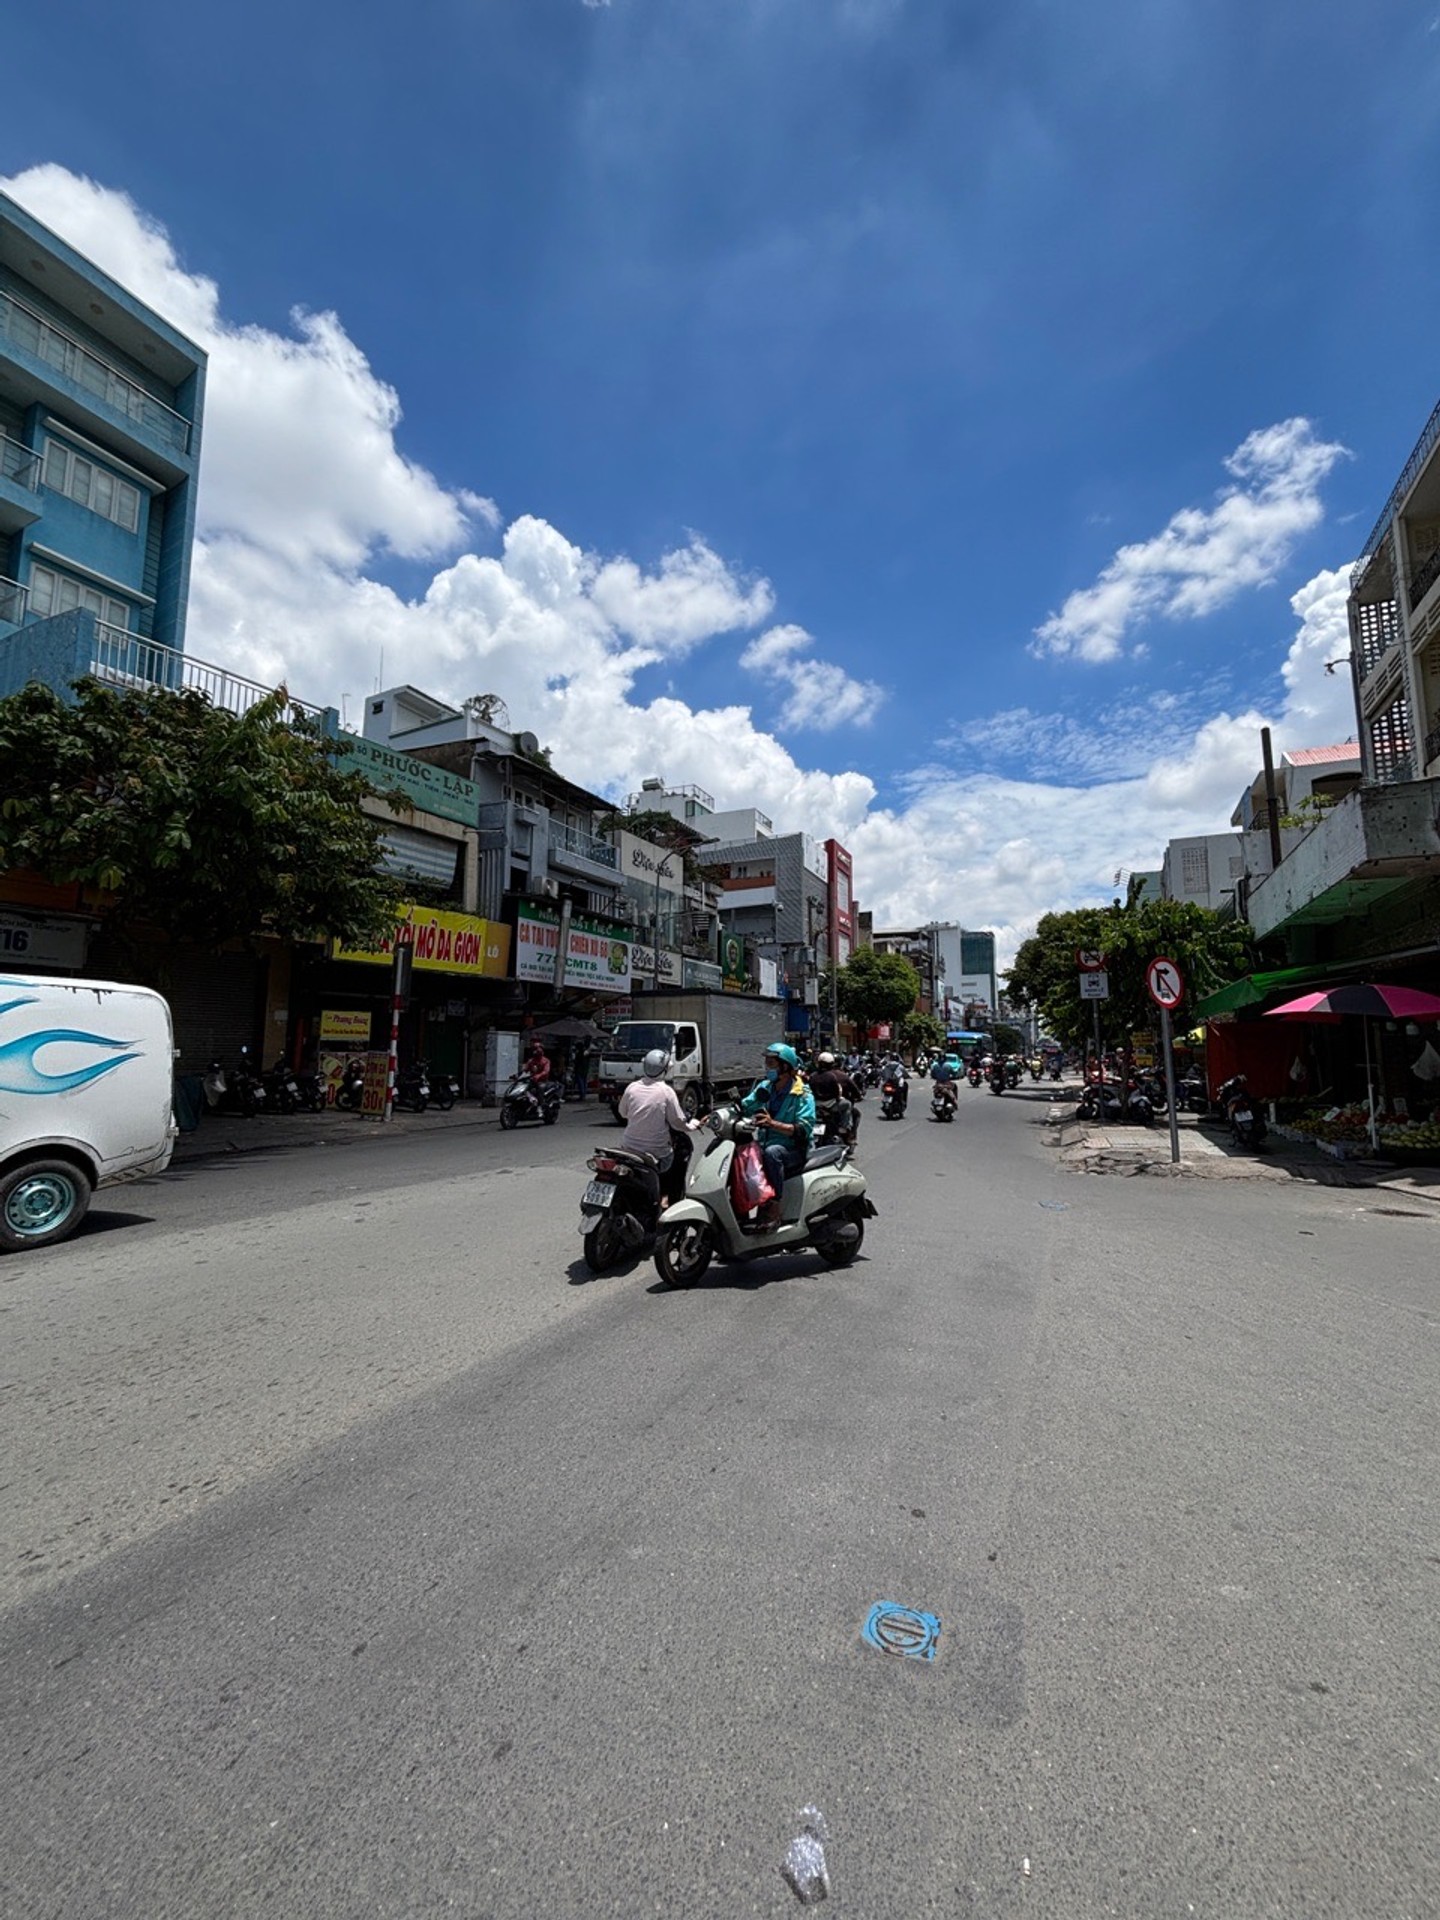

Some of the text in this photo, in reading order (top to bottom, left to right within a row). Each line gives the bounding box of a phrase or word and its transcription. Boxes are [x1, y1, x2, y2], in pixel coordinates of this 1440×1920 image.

[370, 747, 432, 781] PHƯỚC
[436, 928, 451, 961] DA
[564, 957, 598, 972] CMT8
